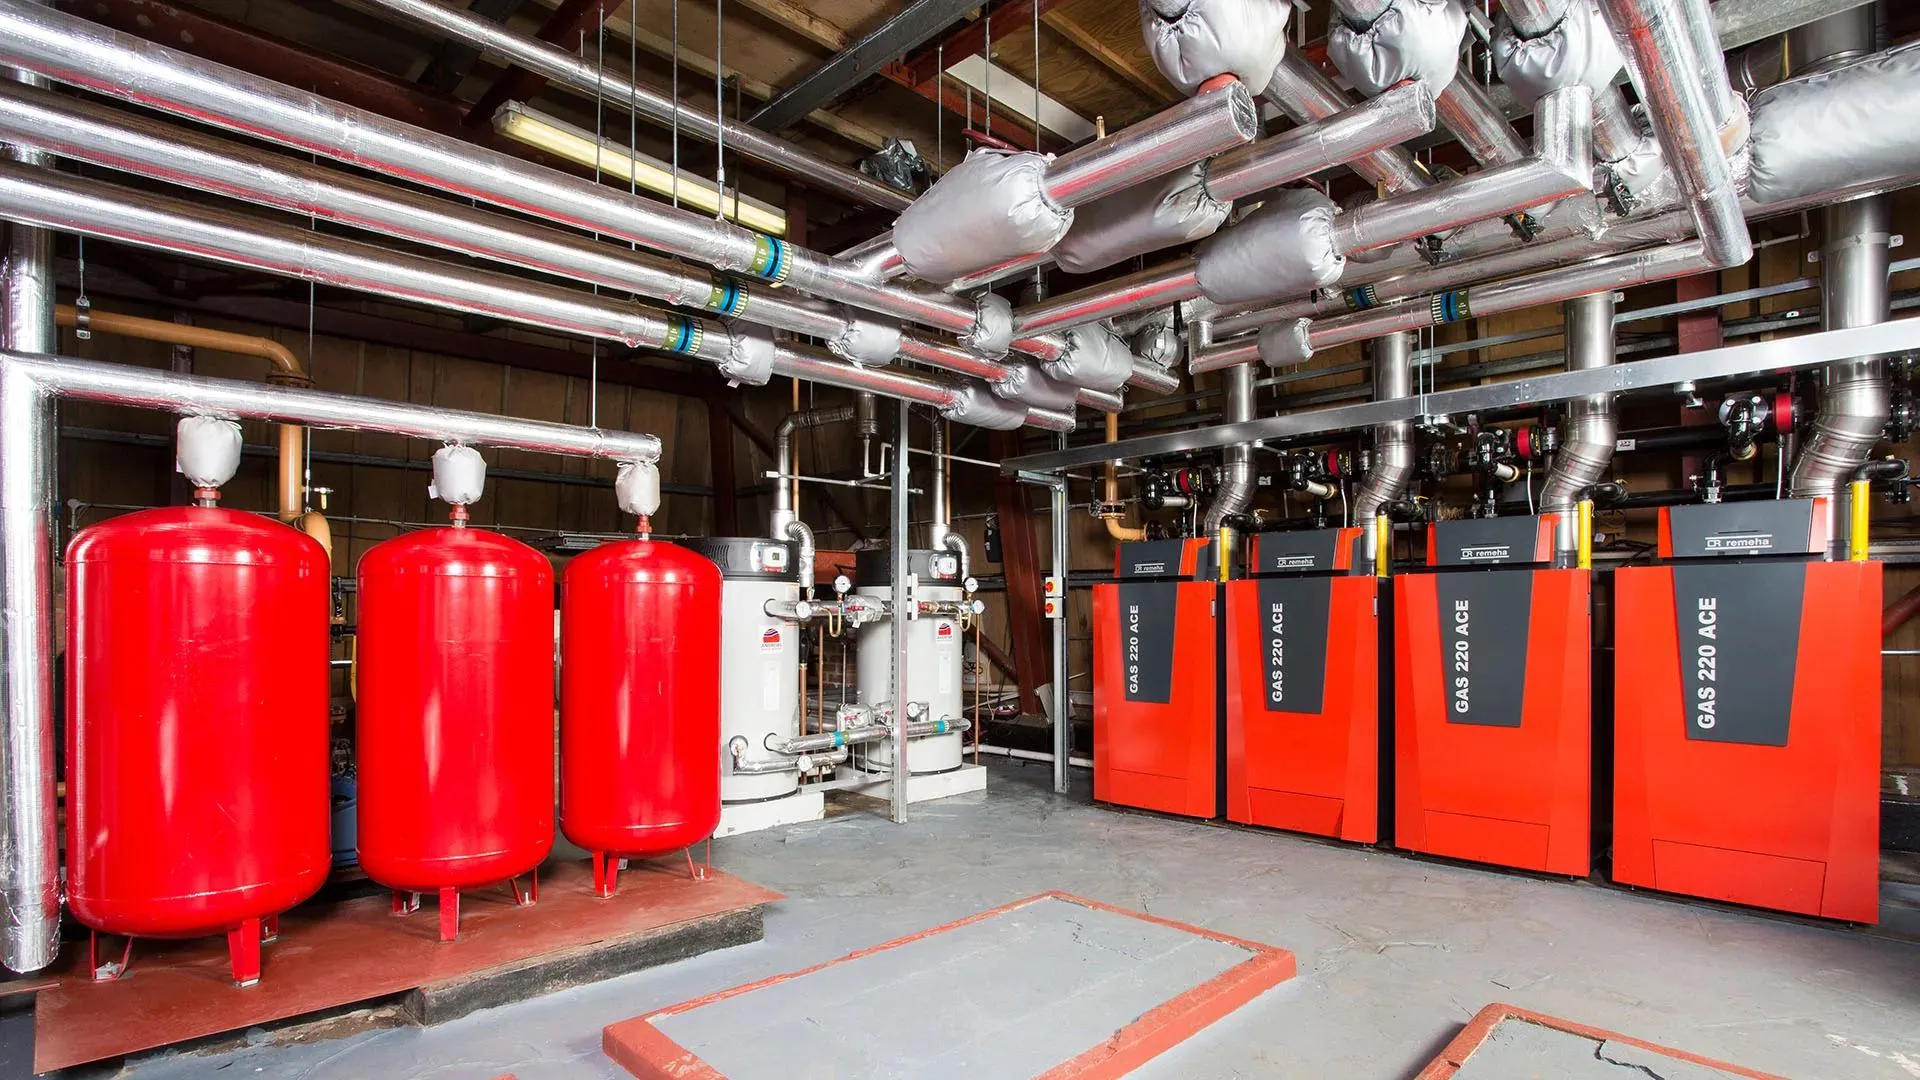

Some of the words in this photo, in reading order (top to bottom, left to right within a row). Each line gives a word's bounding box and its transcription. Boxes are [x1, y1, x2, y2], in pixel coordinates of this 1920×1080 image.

[1476, 549, 1508, 557] remeha
[1726, 537, 1769, 546] remeha
[1129, 605, 1139, 633] ACE
[1272, 602, 1283, 635] ACE
[1455, 600, 1469, 636] ACE
[1698, 597, 1716, 639] ACE
[1129, 637, 1139, 662] 220
[1272, 639, 1283, 667] 220
[1455, 640, 1469, 673] 220
[1698, 644, 1716, 682] 220
[1129, 665, 1139, 694] GAS
[1272, 670, 1283, 703] GAS
[1455, 676, 1469, 714] GAS
[1697, 686, 1715, 729] GAS
